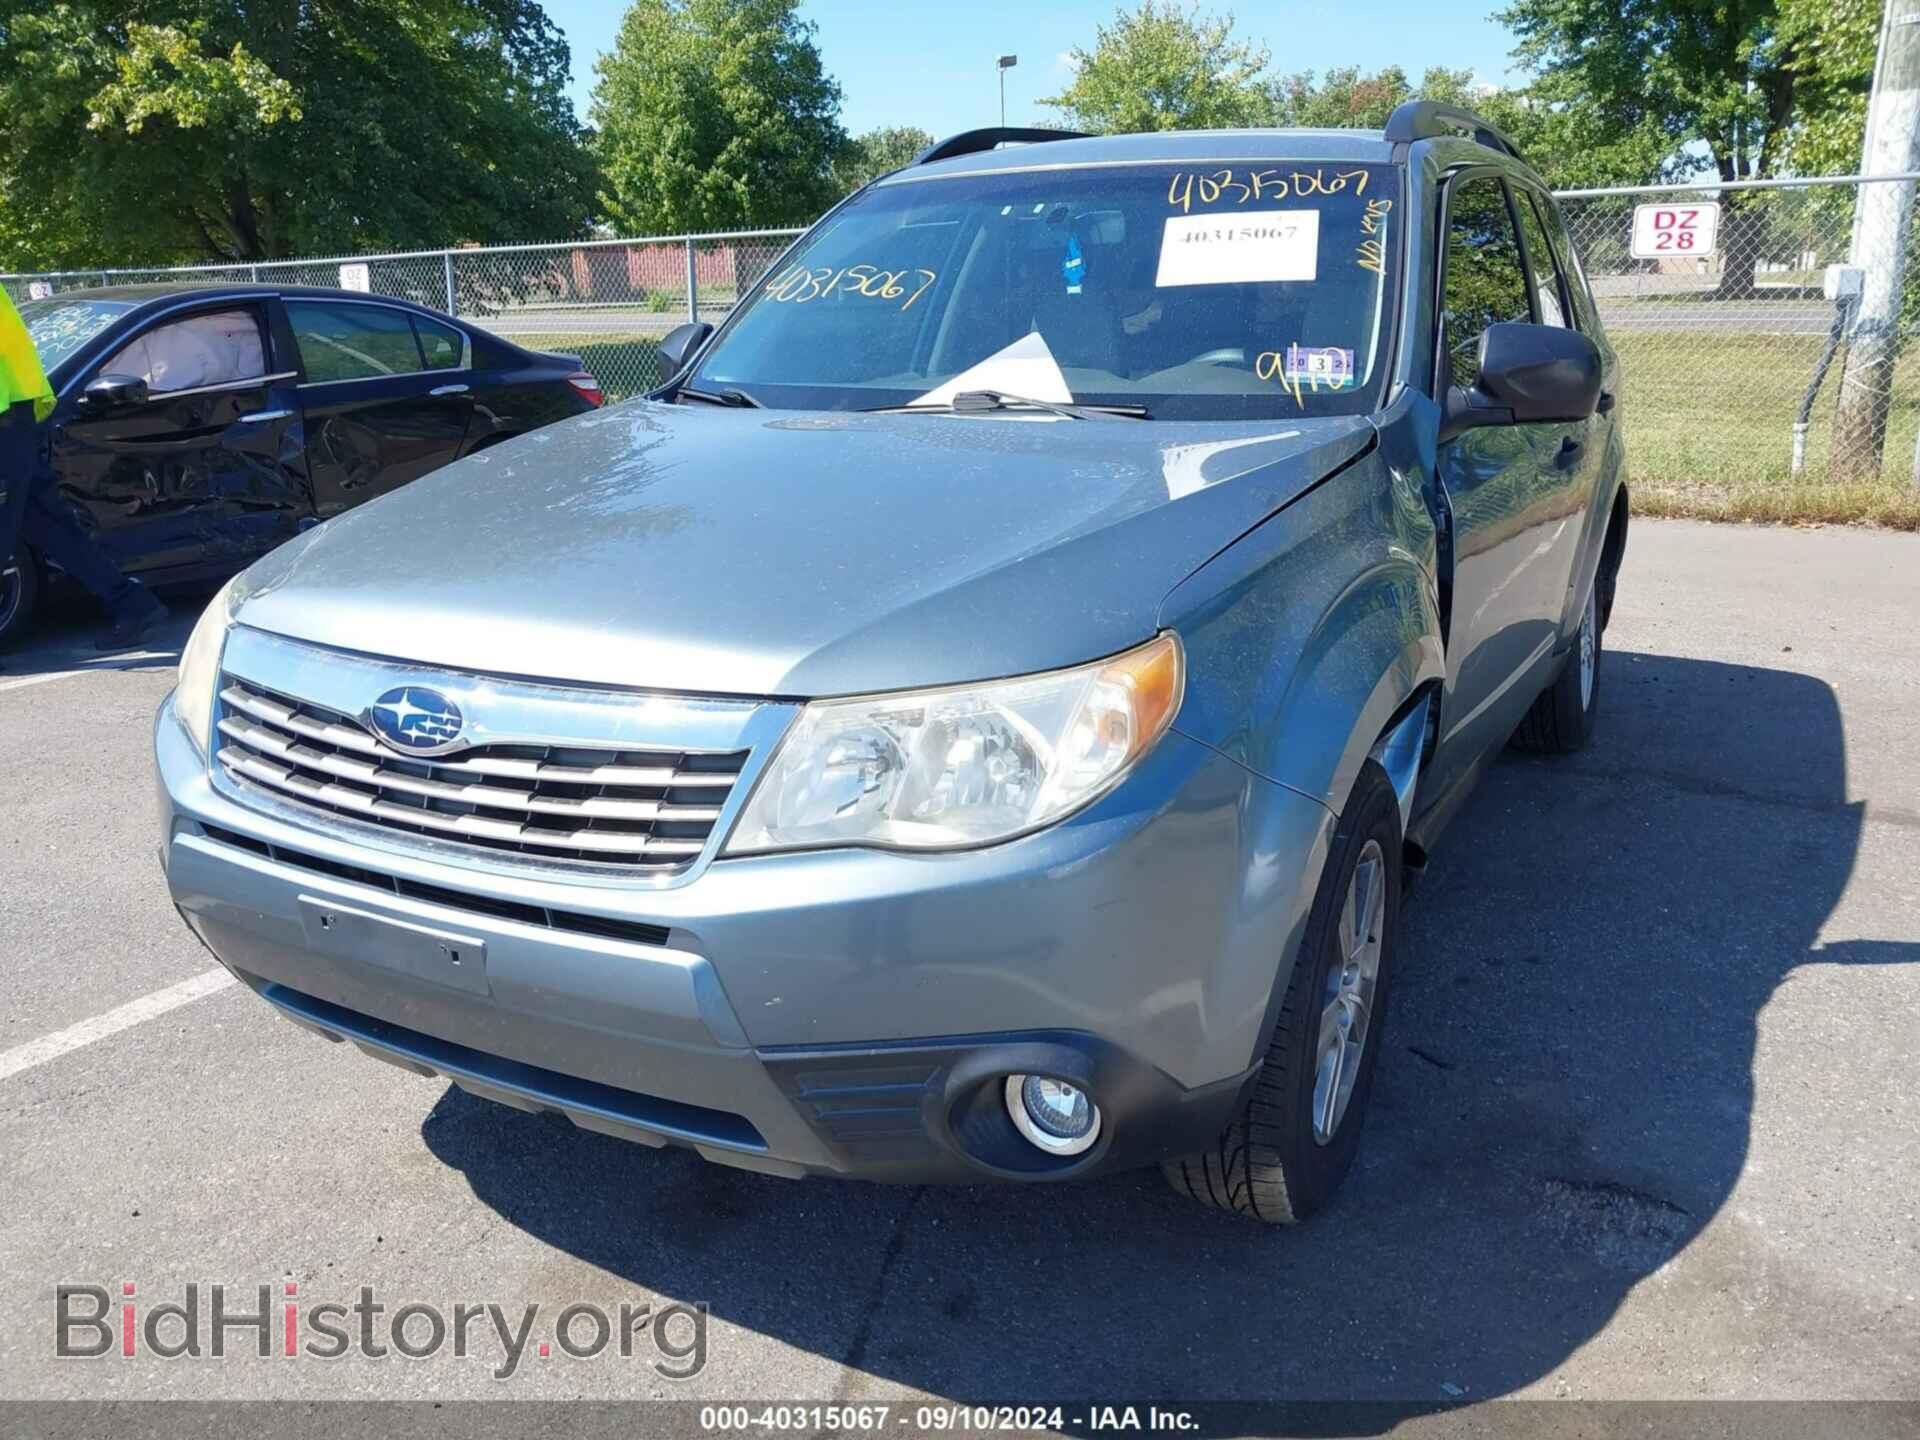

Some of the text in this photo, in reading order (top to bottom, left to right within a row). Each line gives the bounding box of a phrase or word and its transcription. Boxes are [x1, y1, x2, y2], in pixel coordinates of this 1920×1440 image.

[1167, 169, 1369, 213] 40315067
[1654, 210, 1699, 230] DZ
[1178, 226, 1298, 245] 40315067
[1655, 231, 1695, 250] 28
[765, 265, 937, 311] 40315067
[1315, 358, 1326, 371] 3
